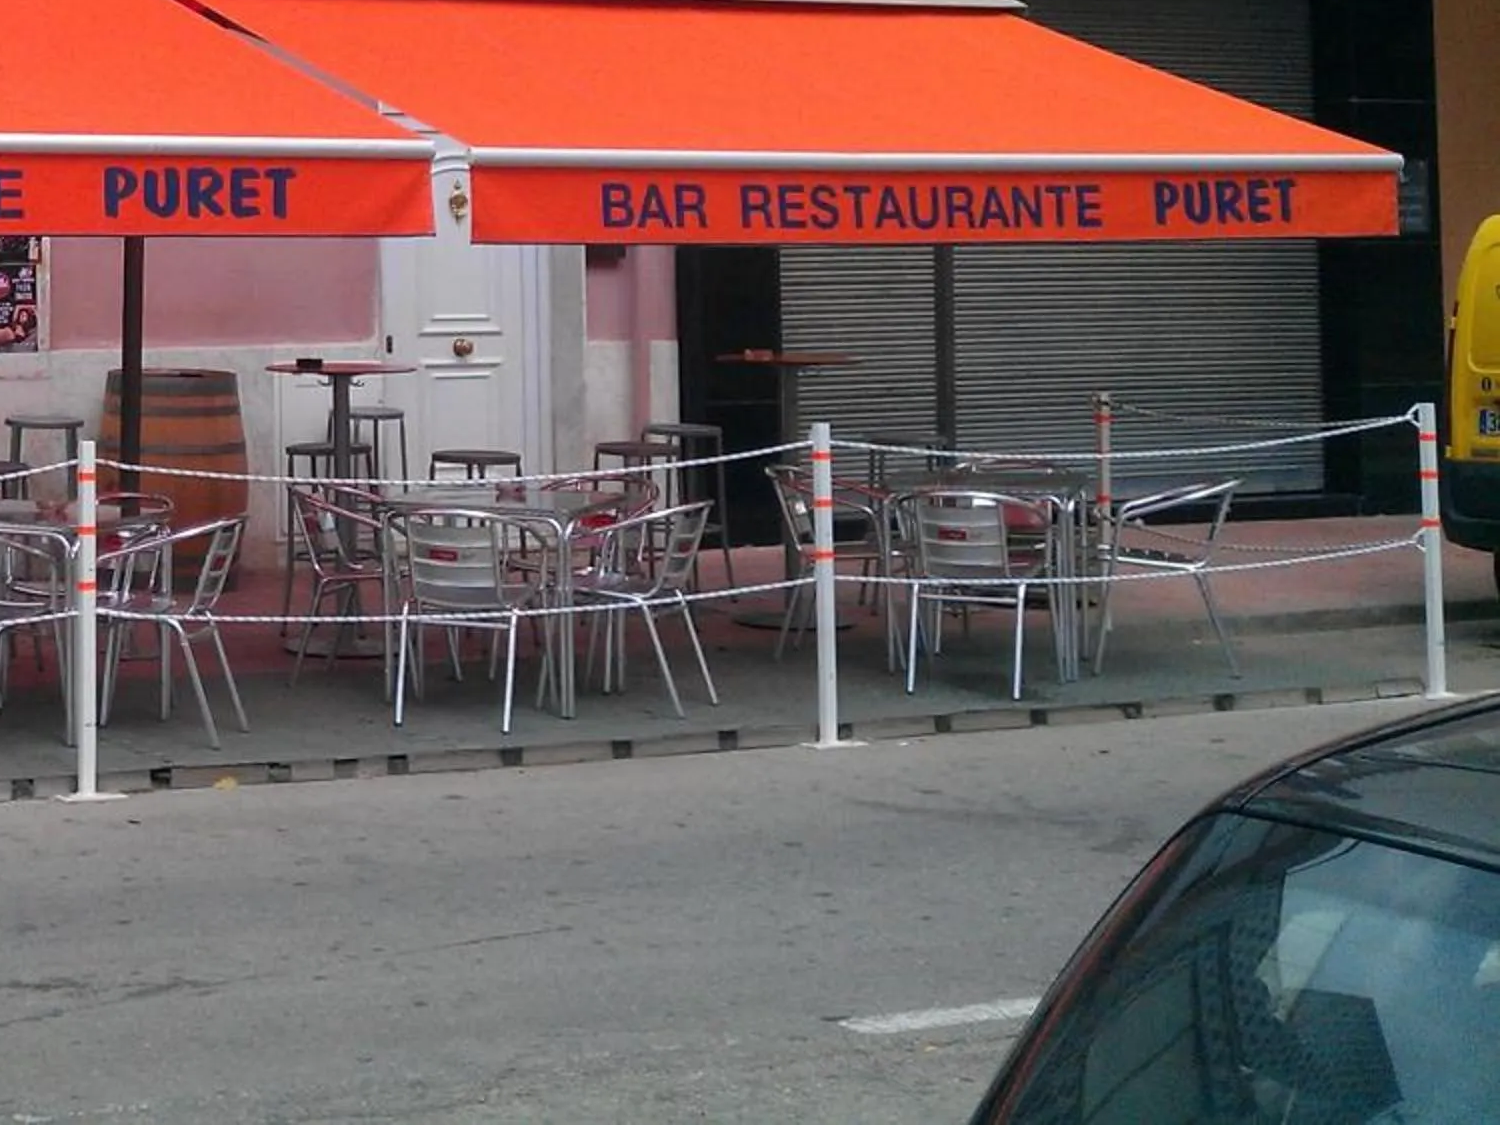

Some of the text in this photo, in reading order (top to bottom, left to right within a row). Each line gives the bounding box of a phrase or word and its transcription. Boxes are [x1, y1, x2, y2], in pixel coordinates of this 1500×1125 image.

[102, 165, 298, 220] PURET
[600, 177, 1300, 231] BAR RESTAURANTE PURET
